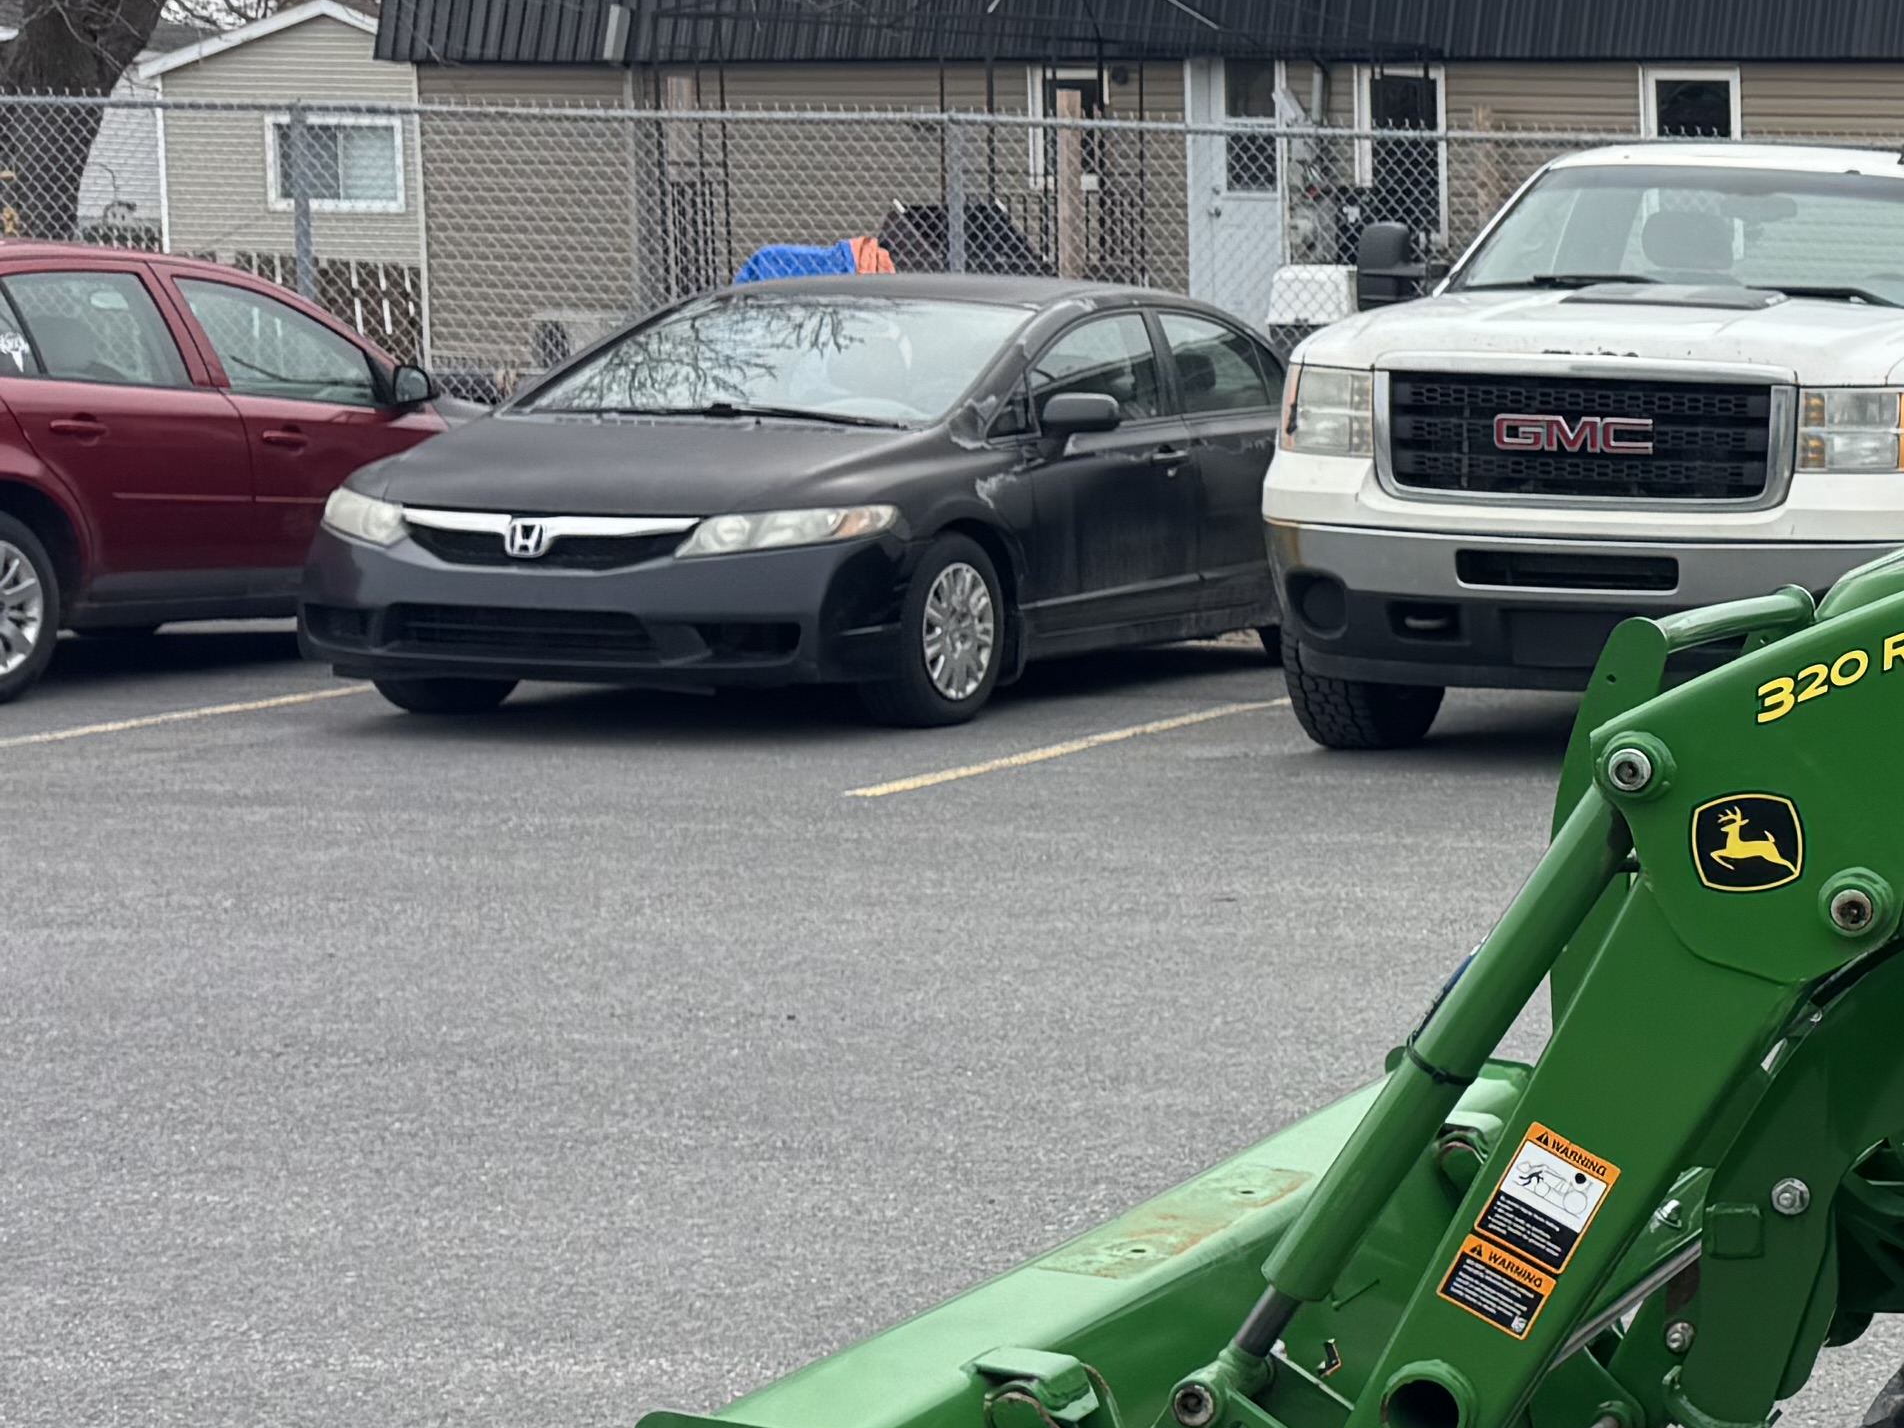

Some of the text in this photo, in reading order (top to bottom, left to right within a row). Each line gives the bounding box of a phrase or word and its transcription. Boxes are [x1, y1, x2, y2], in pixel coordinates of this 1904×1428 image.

[1493, 413, 1654, 455] GMC
[1756, 647, 1870, 724] 320
[1551, 1138, 1608, 1177] WARNING
[1488, 1250, 1544, 1289] WARNING
